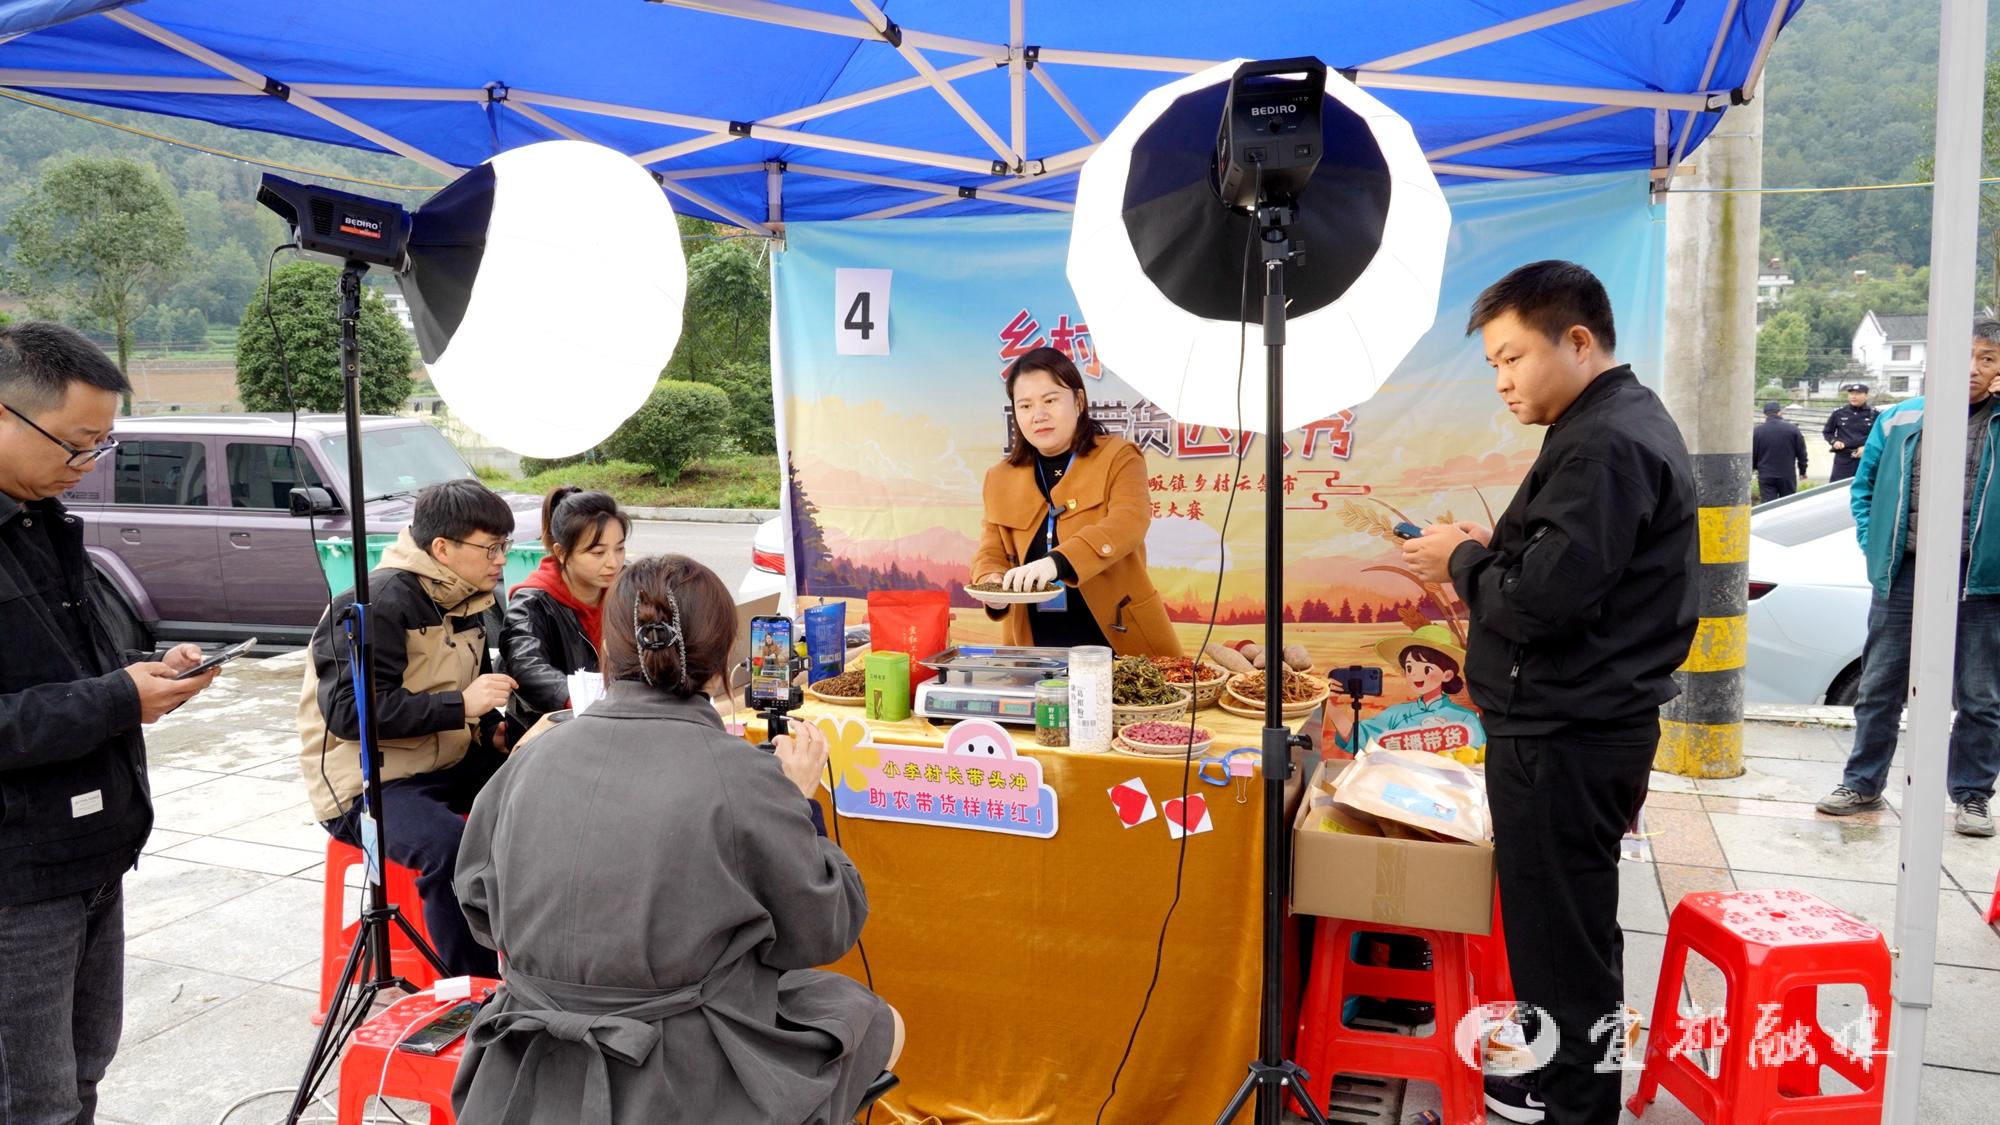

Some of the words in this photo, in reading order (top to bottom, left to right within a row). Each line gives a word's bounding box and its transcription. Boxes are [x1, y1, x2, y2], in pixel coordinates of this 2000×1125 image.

[1251, 104, 1297, 116] BEDIRO
[344, 217, 379, 230] BEDIRO
[844, 292, 874, 340] 4
[1384, 727, 1463, 751] 直播带货
[882, 760, 1028, 792] 小李村长带头冲
